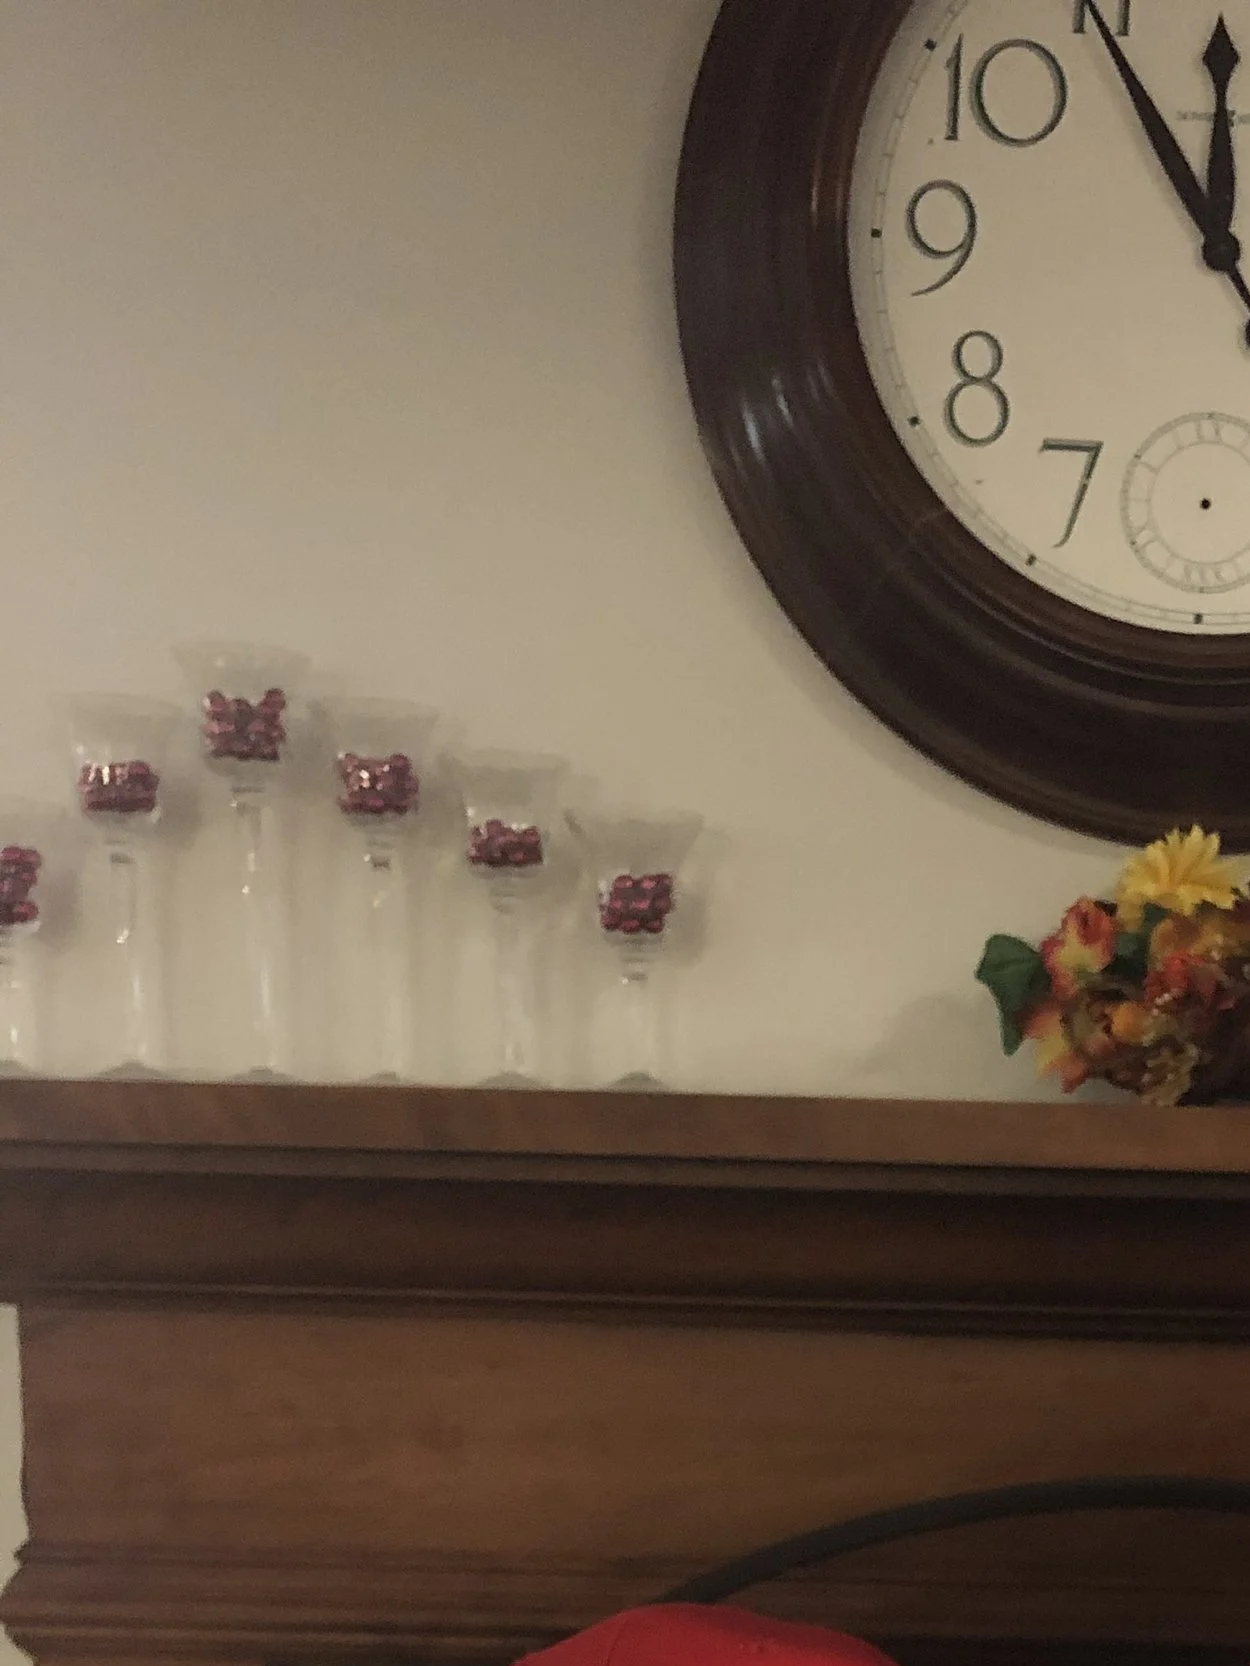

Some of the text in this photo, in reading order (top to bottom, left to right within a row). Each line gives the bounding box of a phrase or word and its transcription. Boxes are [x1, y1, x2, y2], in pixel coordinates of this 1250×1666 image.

[945, 34, 1067, 147] 10
[905, 179, 977, 297] 9
[942, 330, 1010, 447] 8
[1038, 437, 1104, 549] 7
